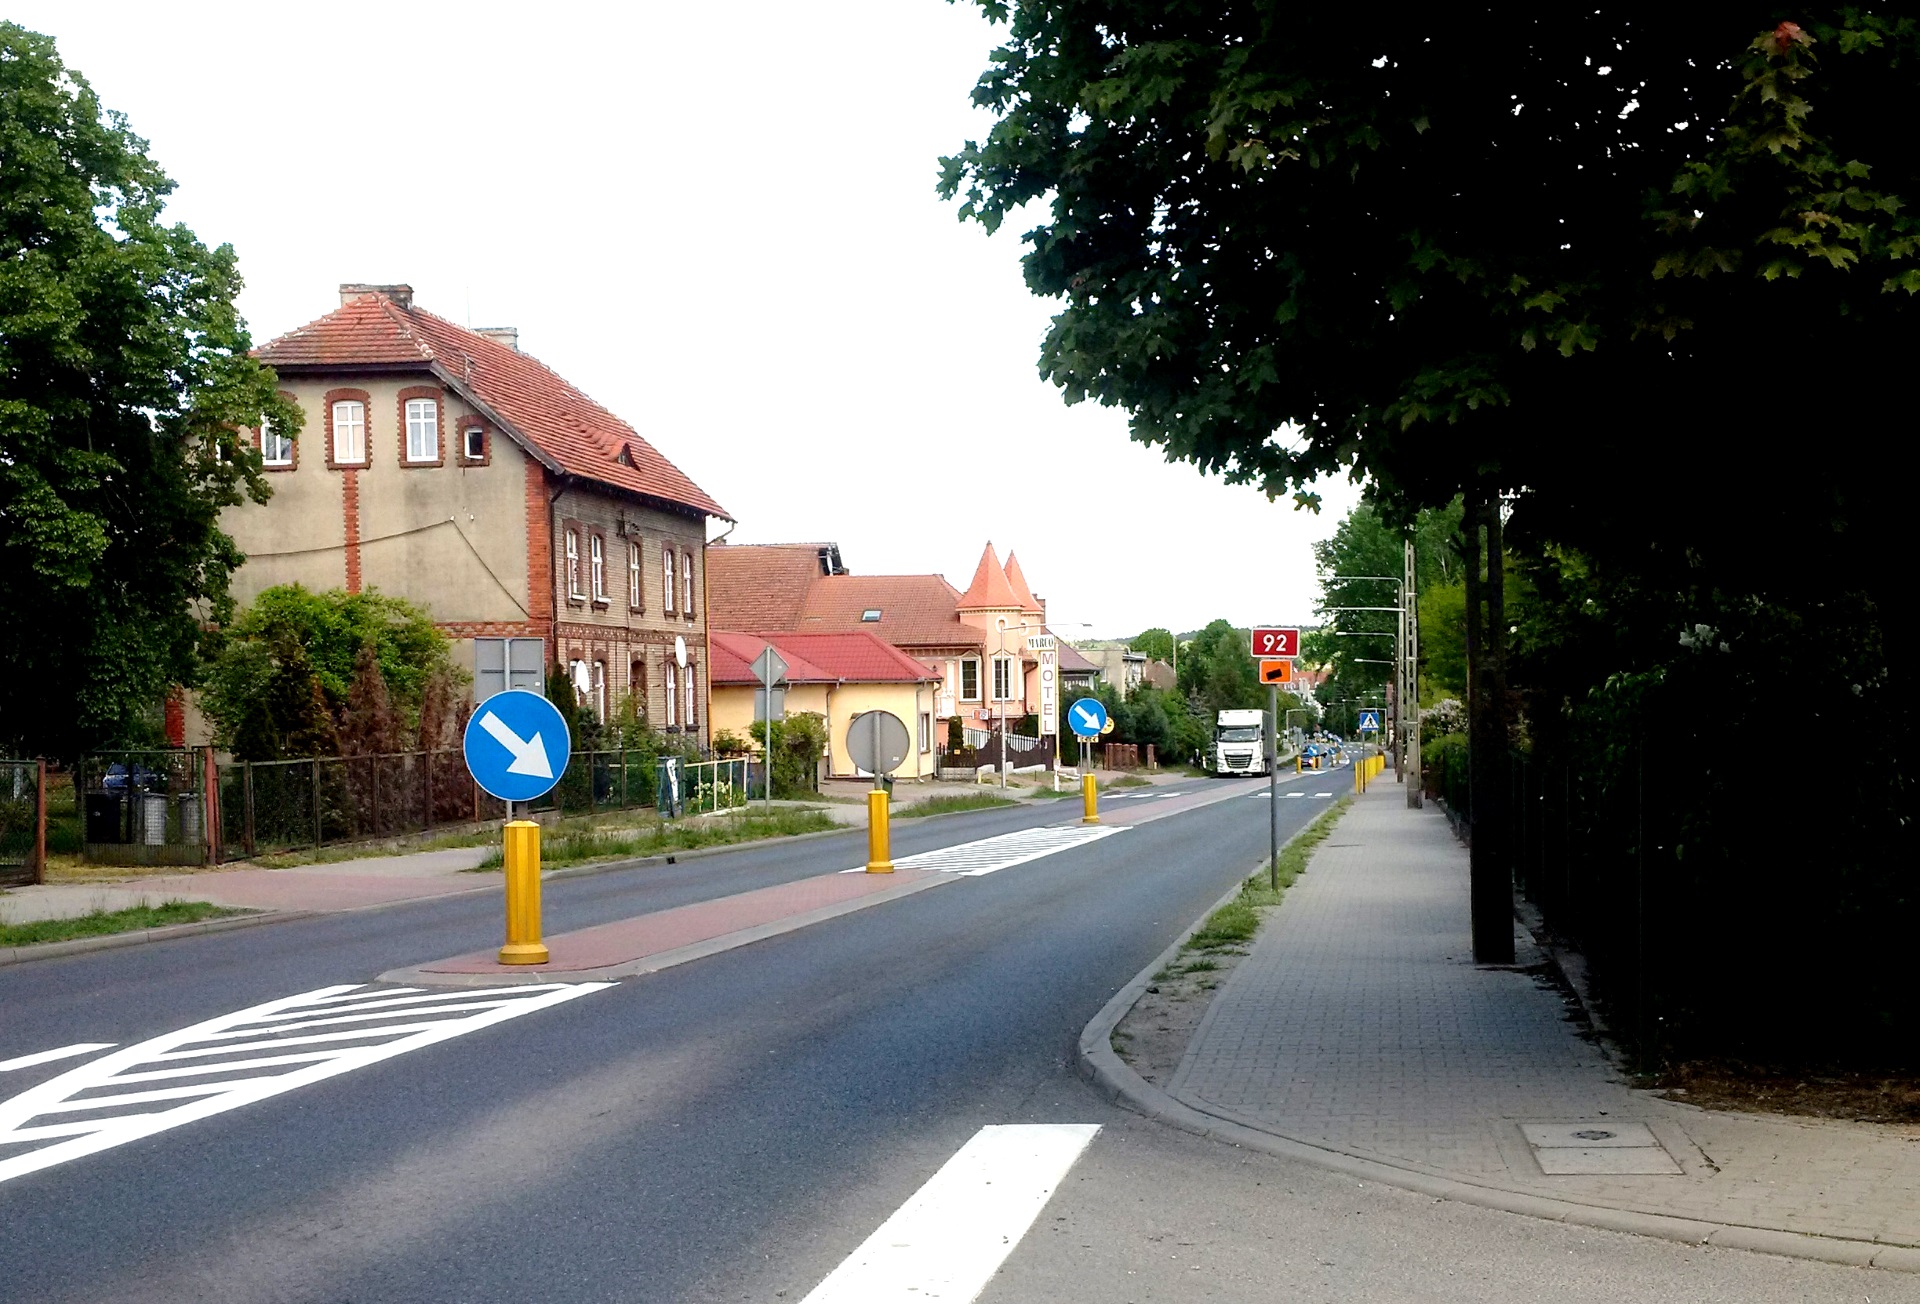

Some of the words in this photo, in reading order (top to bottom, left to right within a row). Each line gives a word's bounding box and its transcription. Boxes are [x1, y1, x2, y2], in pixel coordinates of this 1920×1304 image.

[1028, 637, 1054, 648] MARCO
[1263, 634, 1287, 652] 92
[1042, 653, 1054, 732] MOTEL
